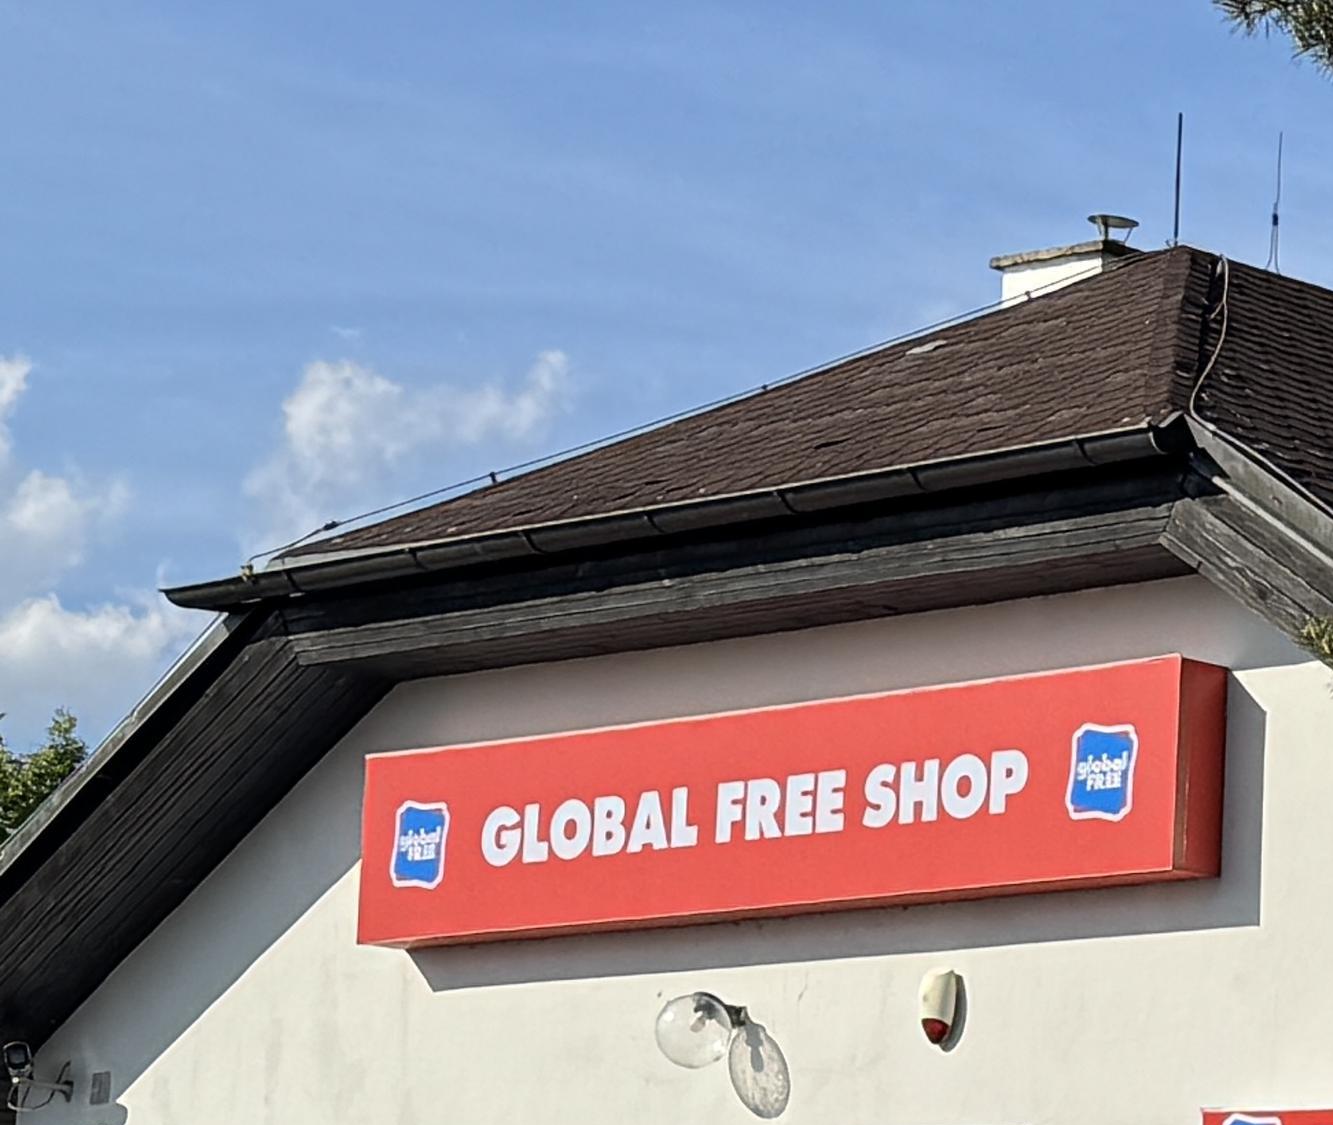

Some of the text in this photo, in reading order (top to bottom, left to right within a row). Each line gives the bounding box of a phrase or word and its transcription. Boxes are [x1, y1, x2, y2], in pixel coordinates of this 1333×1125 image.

[1077, 750, 1129, 781] global
[1086, 770, 1122, 791] FREE
[482, 749, 1029, 867] GLOBAL FREE SHOP
